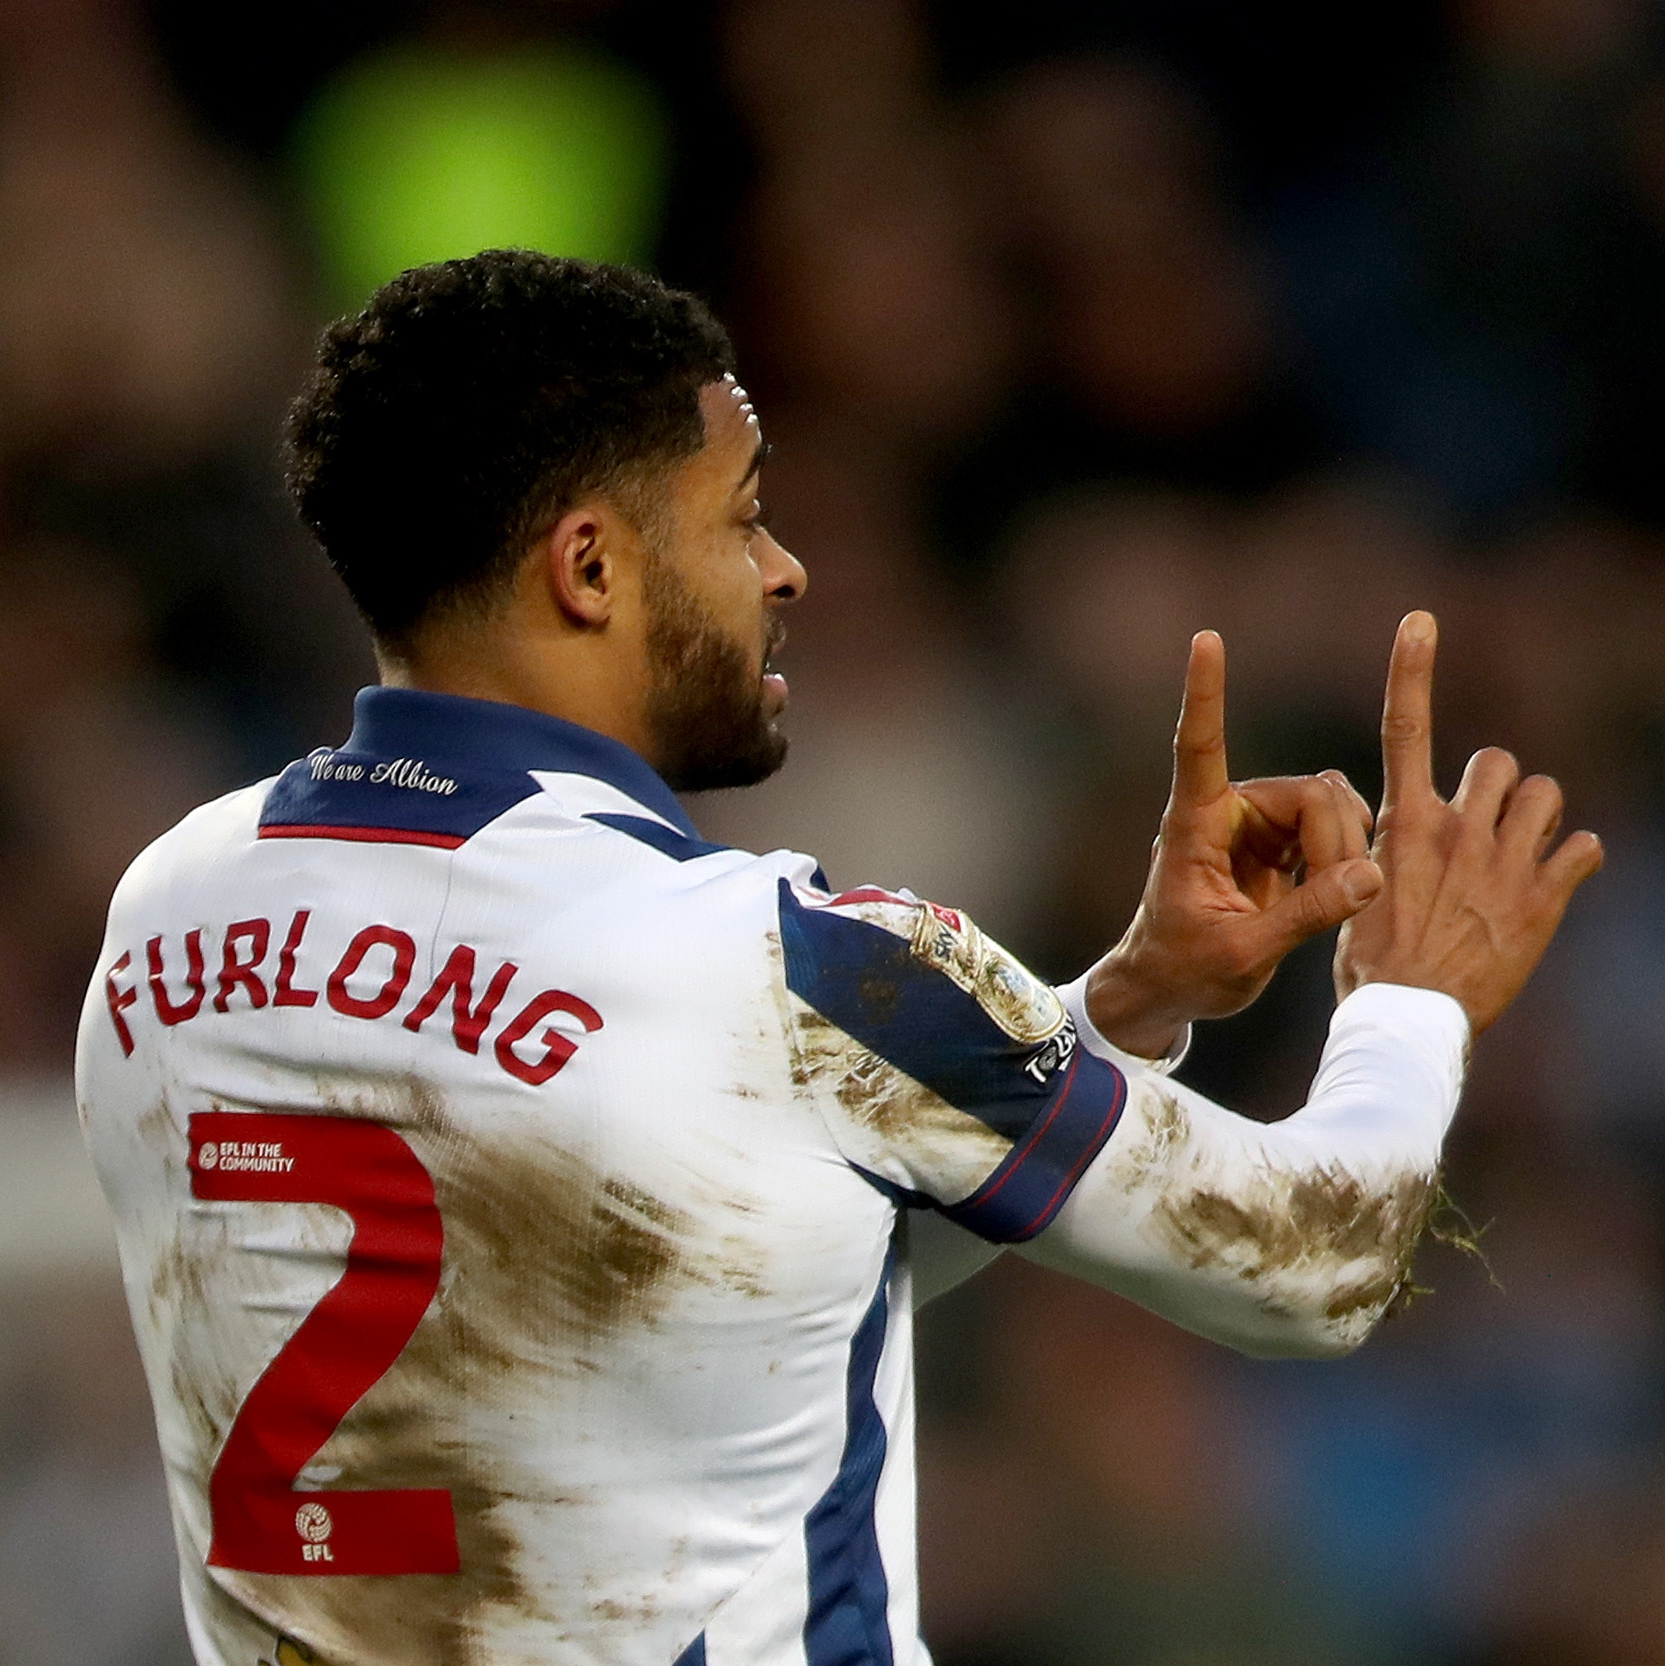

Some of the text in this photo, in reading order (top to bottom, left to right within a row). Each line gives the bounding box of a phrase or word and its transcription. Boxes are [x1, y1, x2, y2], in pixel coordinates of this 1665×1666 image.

[310, 753, 459, 795] We are Albion
[107, 910, 603, 1086] FURLONG
[219, 1156, 295, 1172] COMMUNITY
[220, 1142, 282, 1157] EFL IN THE
[188, 1111, 461, 1576] 2
[301, 1543, 334, 1562] EFL
